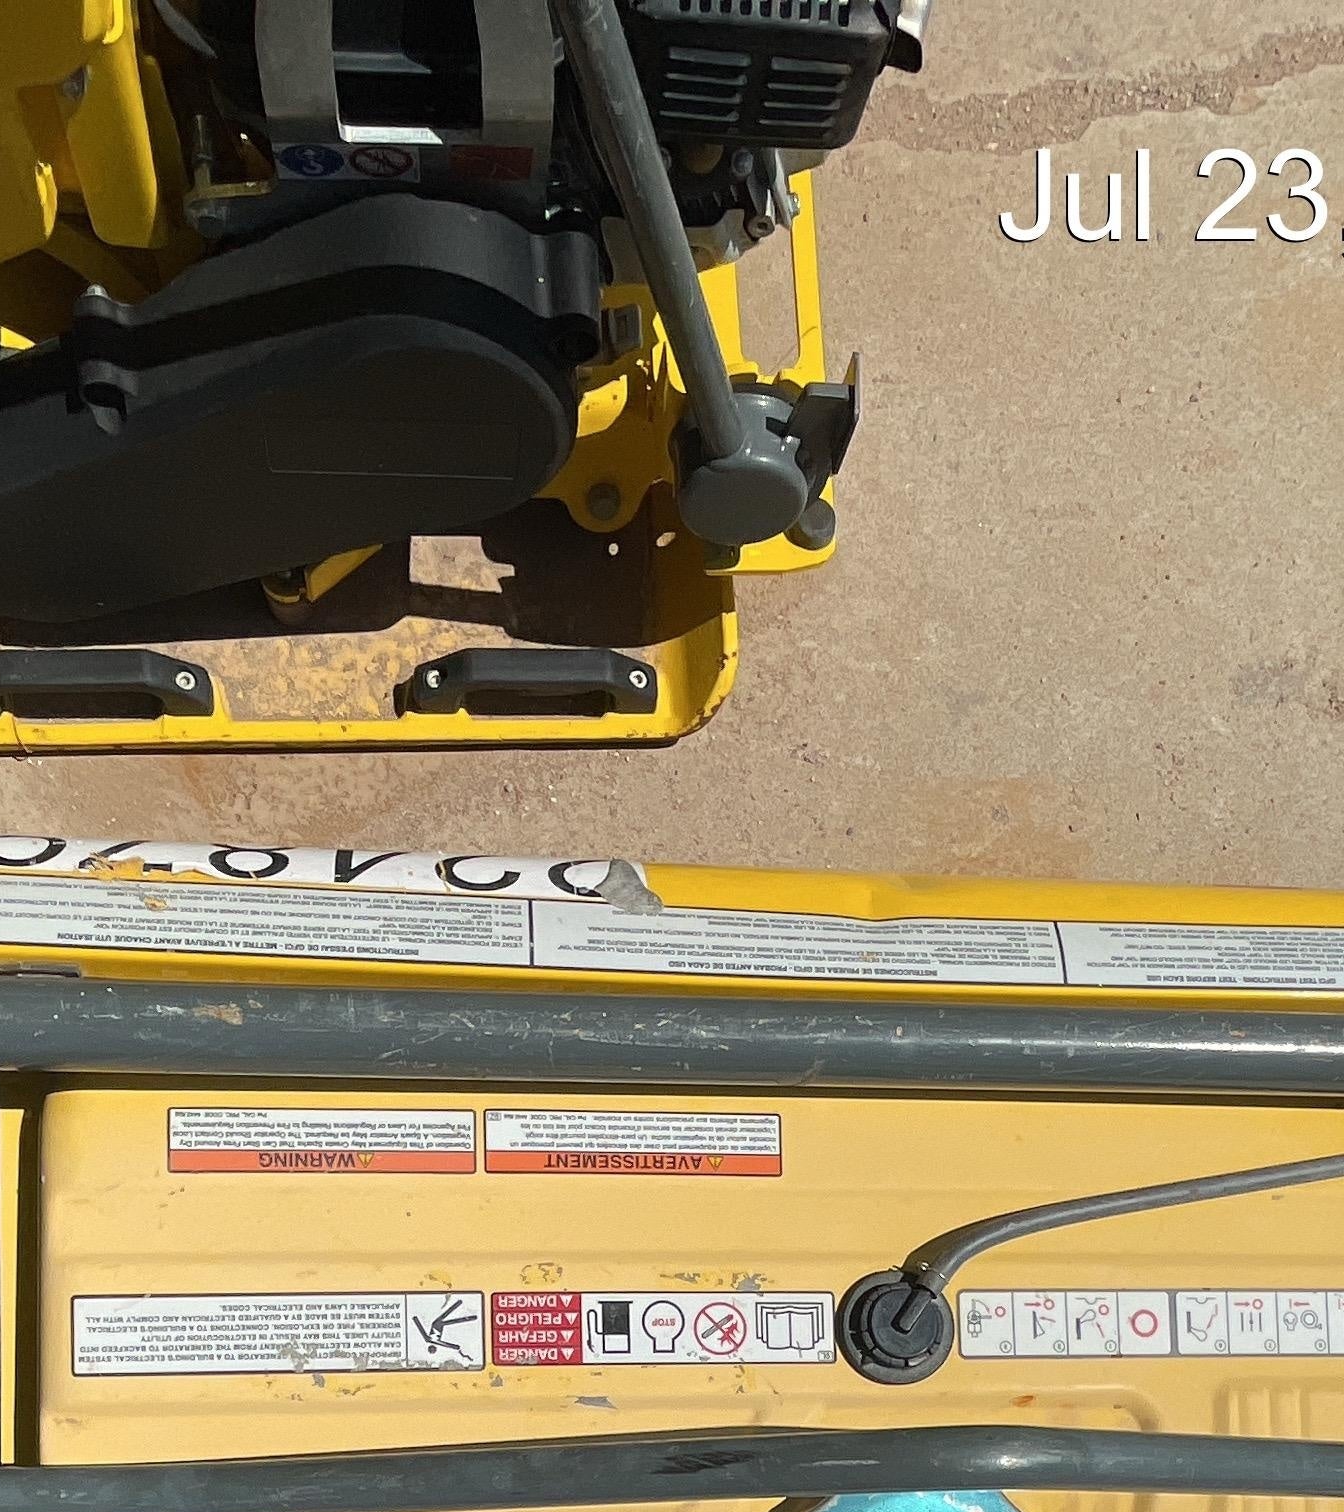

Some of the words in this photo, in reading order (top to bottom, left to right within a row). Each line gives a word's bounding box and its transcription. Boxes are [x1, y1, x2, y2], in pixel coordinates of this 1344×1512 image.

[259, 1153, 354, 1167] WARNING
[545, 1154, 702, 1168] AVERTISSEMENT
[499, 1296, 557, 1307] DANGER
[253, 1304, 304, 1312] ELECTRICAL
[350, 1303, 400, 1311] APPLICABLE
[103, 1316, 125, 1324] WITH
[181, 1315, 236, 1323] ELECTRICIAN
[238, 1313, 282, 1322] QUALIFIED
[496, 1313, 562, 1325] PELIGRO
[652, 1318, 676, 1327] STOP
[141, 1335, 173, 1343] UTILITY
[187, 1334, 257, 1342] ELECTROCUTION
[303, 1333, 321, 1341] MAY
[499, 1330, 558, 1342] GEFAHR
[499, 1348, 558, 1360] DANGER
